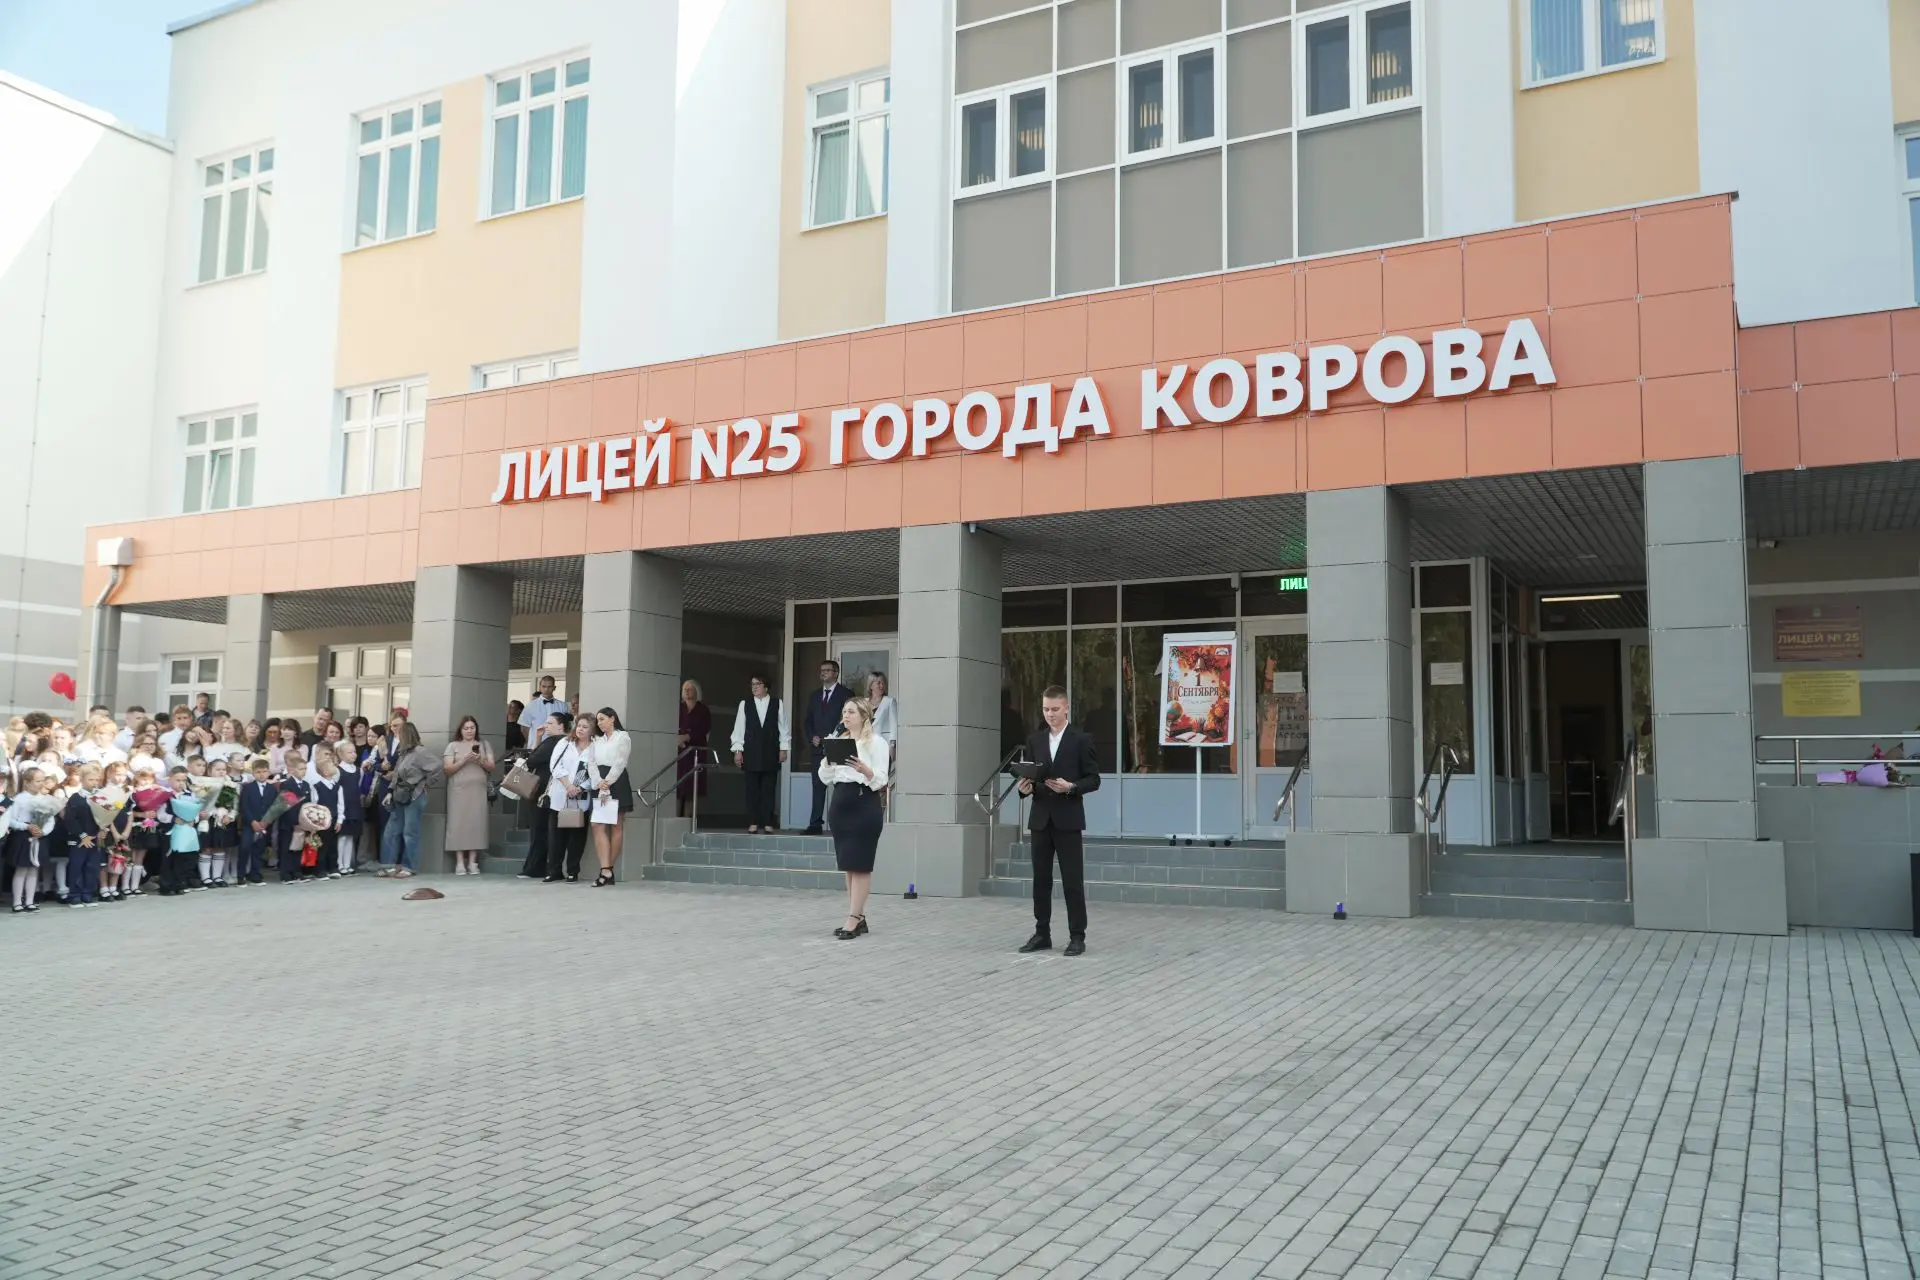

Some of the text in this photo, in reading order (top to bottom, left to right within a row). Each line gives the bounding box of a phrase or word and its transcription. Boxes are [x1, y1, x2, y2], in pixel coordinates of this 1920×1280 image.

[491, 318, 1557, 503] ЛИЦЕЙ N25 ГОРОДА КОВРОВА
[1778, 632, 1824, 644] ЛИЦЕЙ
[1845, 632, 1860, 642] 25
[1195, 673, 1202, 686] 1
